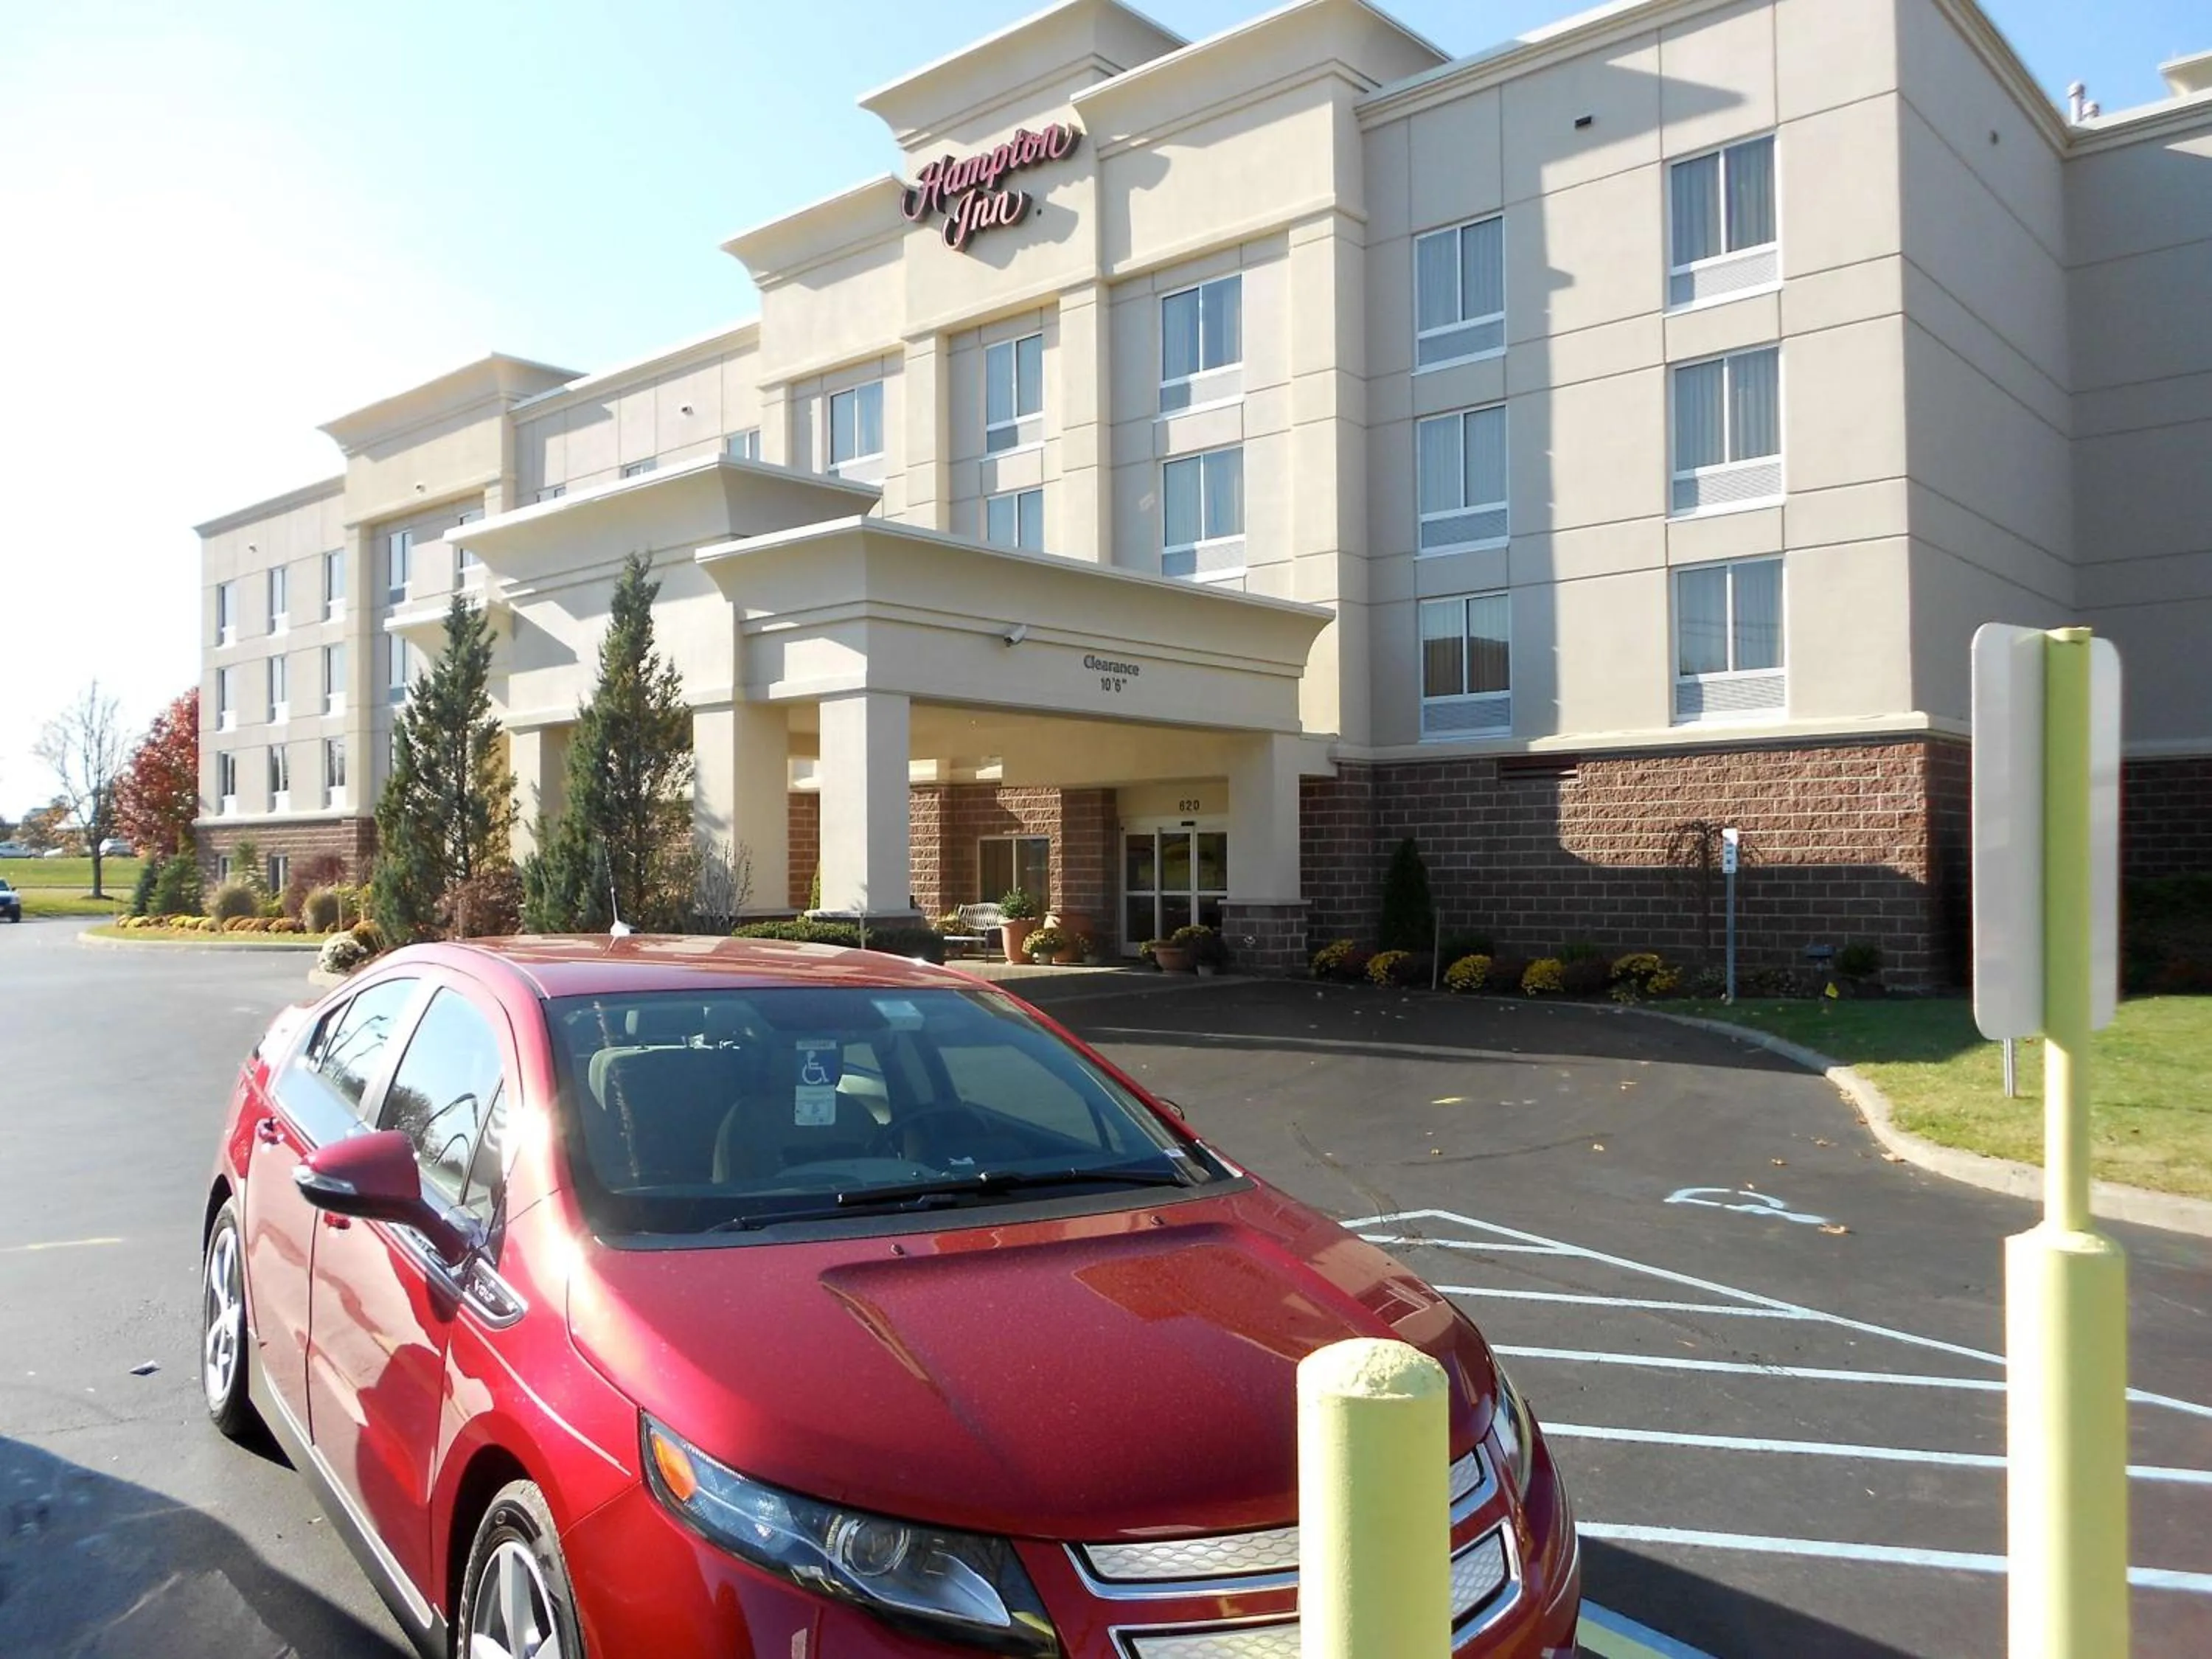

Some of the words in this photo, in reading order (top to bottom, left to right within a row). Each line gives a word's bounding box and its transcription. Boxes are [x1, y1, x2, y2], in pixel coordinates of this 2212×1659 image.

[900, 122, 1082, 221] Hampton
[941, 188, 1032, 251] Inn
[1083, 654, 1139, 676] Clearance
[1180, 800, 1200, 812] 620
